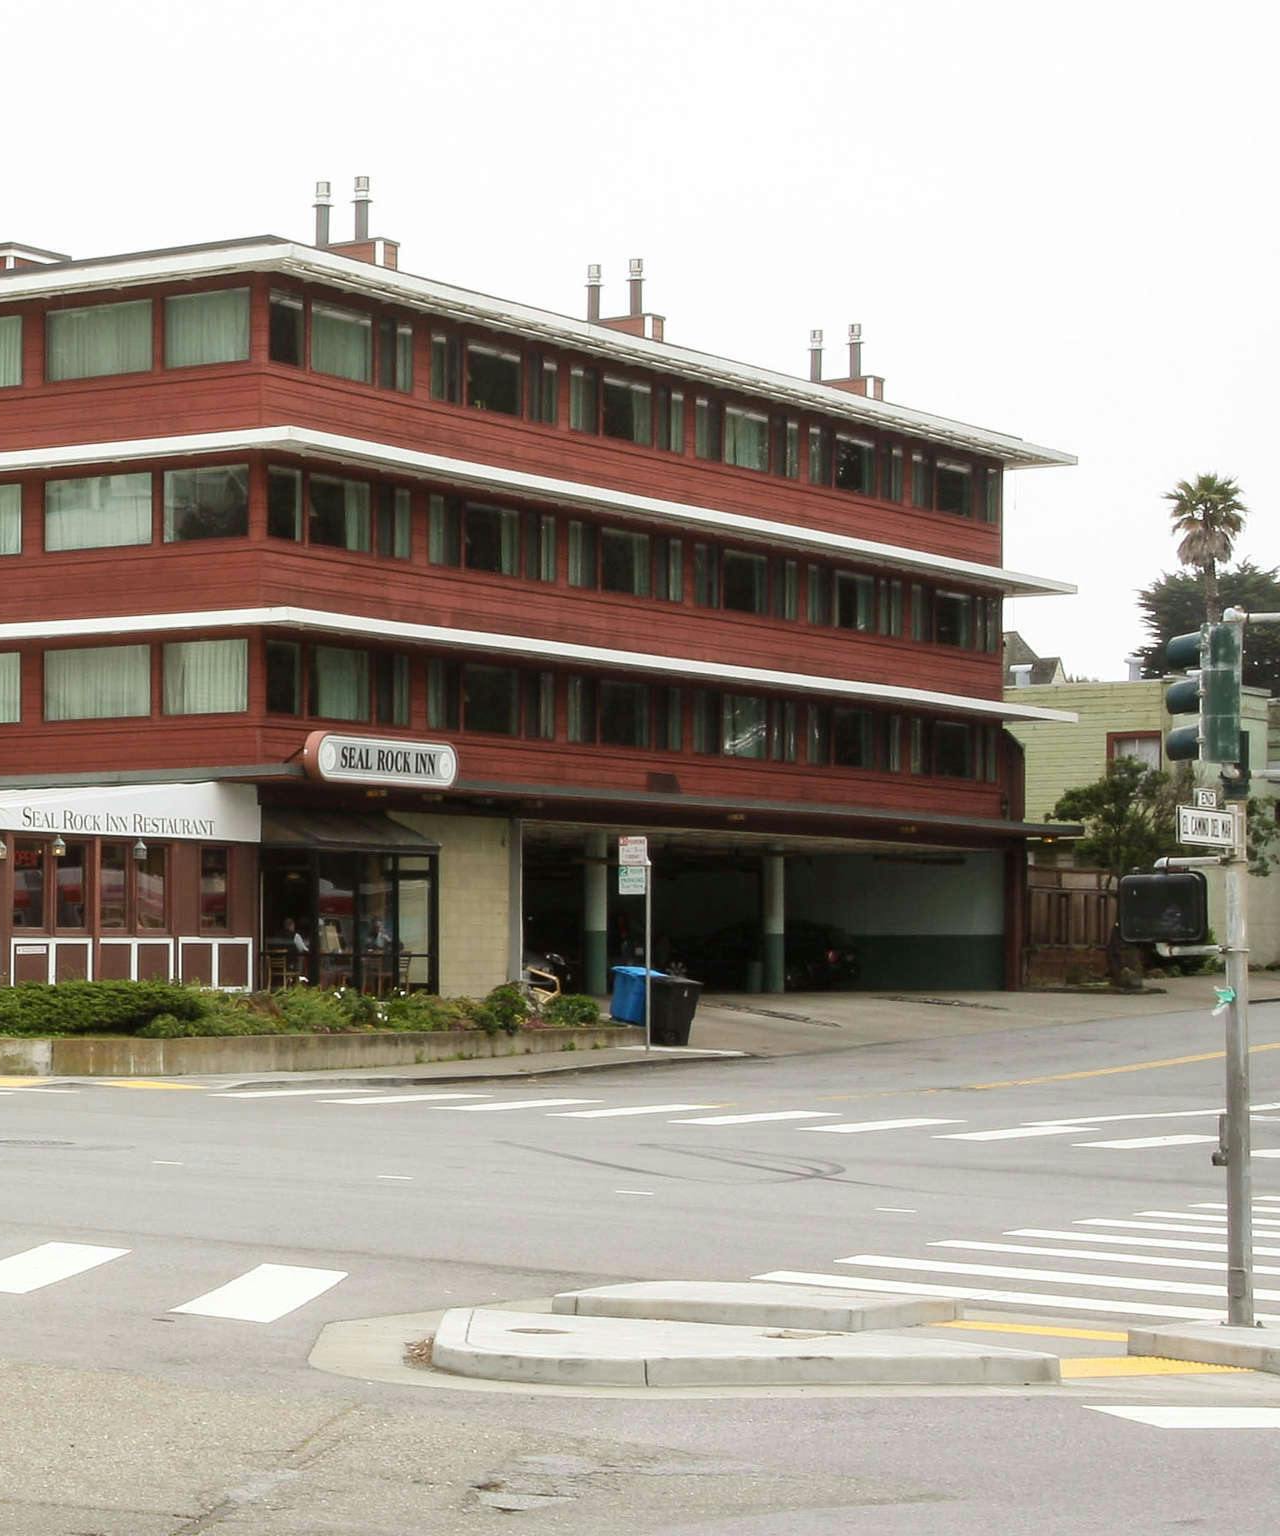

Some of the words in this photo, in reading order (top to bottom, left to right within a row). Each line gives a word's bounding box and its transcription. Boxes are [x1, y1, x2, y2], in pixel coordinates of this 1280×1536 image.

[340, 745, 372, 770] SEAL
[376, 749, 411, 774] ROCK
[414, 752, 436, 776] INN
[1201, 792, 1214, 805] END
[21, 806, 60, 830] SEAL
[63, 809, 102, 832] ROCK
[105, 812, 129, 833] INN
[132, 813, 216, 836] RESTAURANT
[1183, 815, 1189, 834] EL
[1210, 818, 1219, 837] DEL
[1221, 819, 1231, 839] MAR
